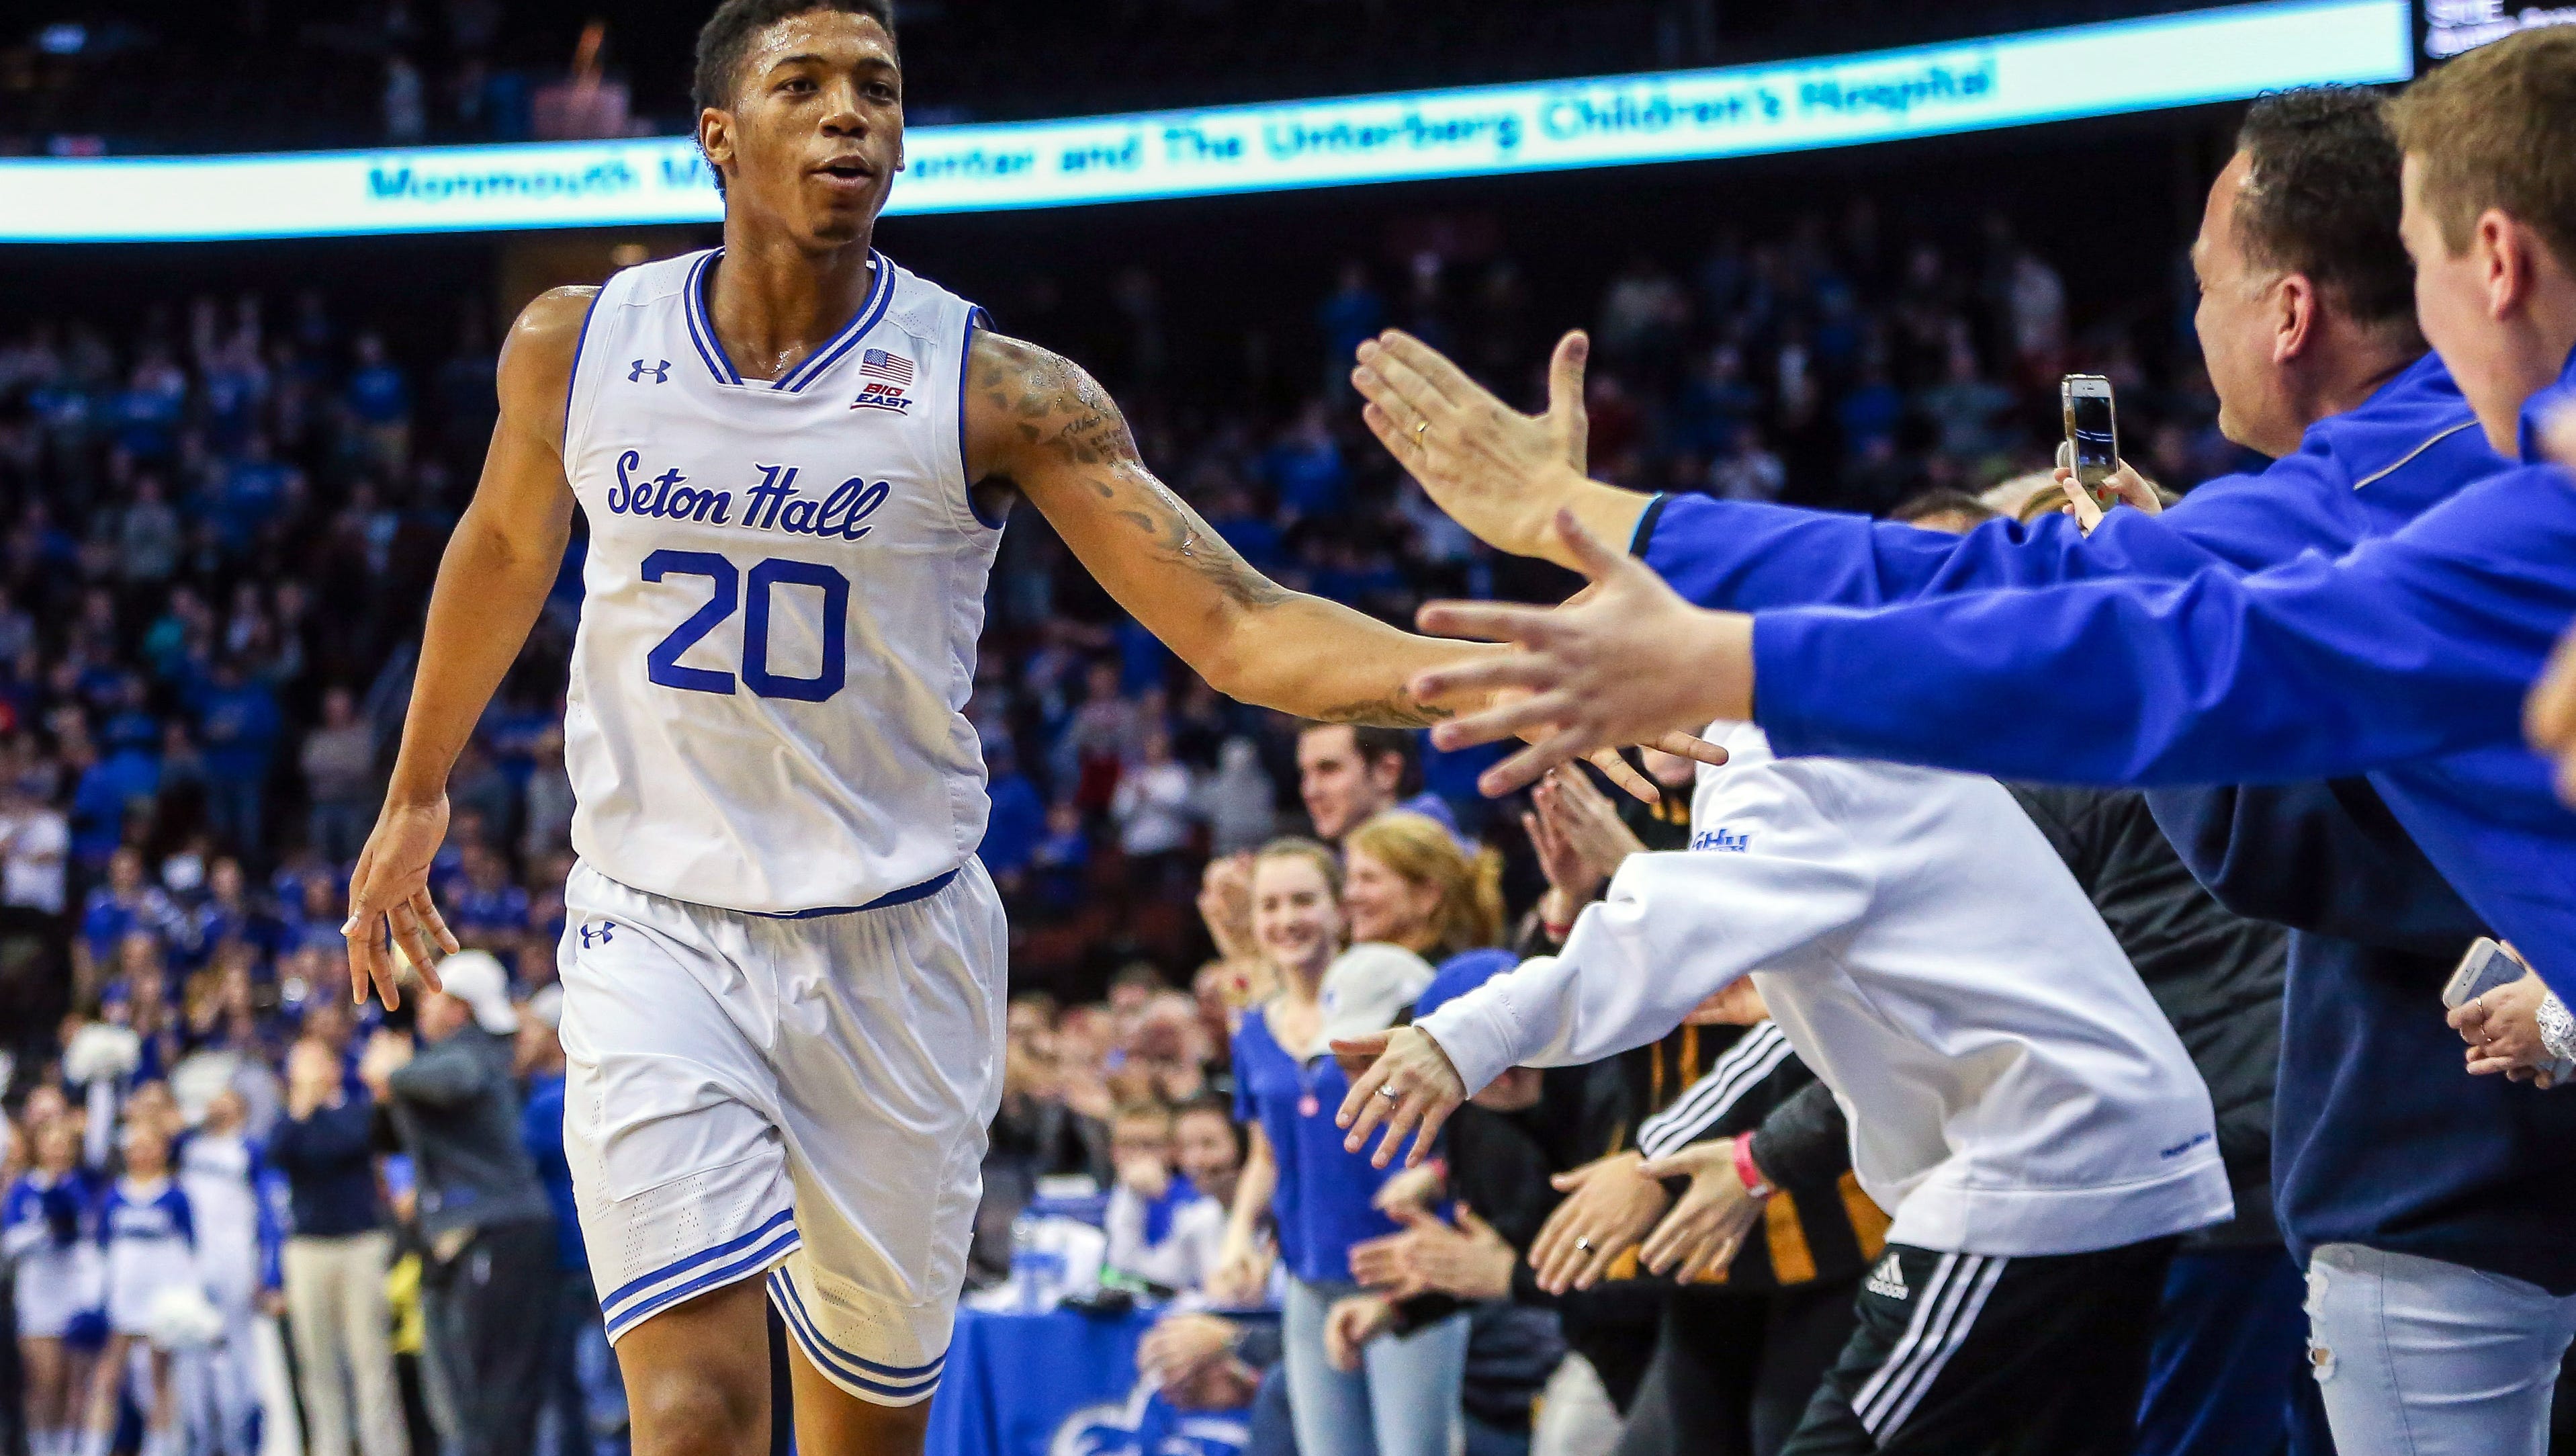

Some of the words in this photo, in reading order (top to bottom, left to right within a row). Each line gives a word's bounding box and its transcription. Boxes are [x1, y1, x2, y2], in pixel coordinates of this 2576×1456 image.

[1061, 132, 1142, 175] and
[1158, 122, 1241, 165] The
[1544, 93, 1783, 140] Children's
[1800, 63, 1991, 117] Hospital
[854, 392, 913, 409] EAST
[863, 383, 905, 396] BIG
[607, 449, 734, 525] Seton
[740, 461, 891, 542] Hall
[641, 549, 850, 703] 20
